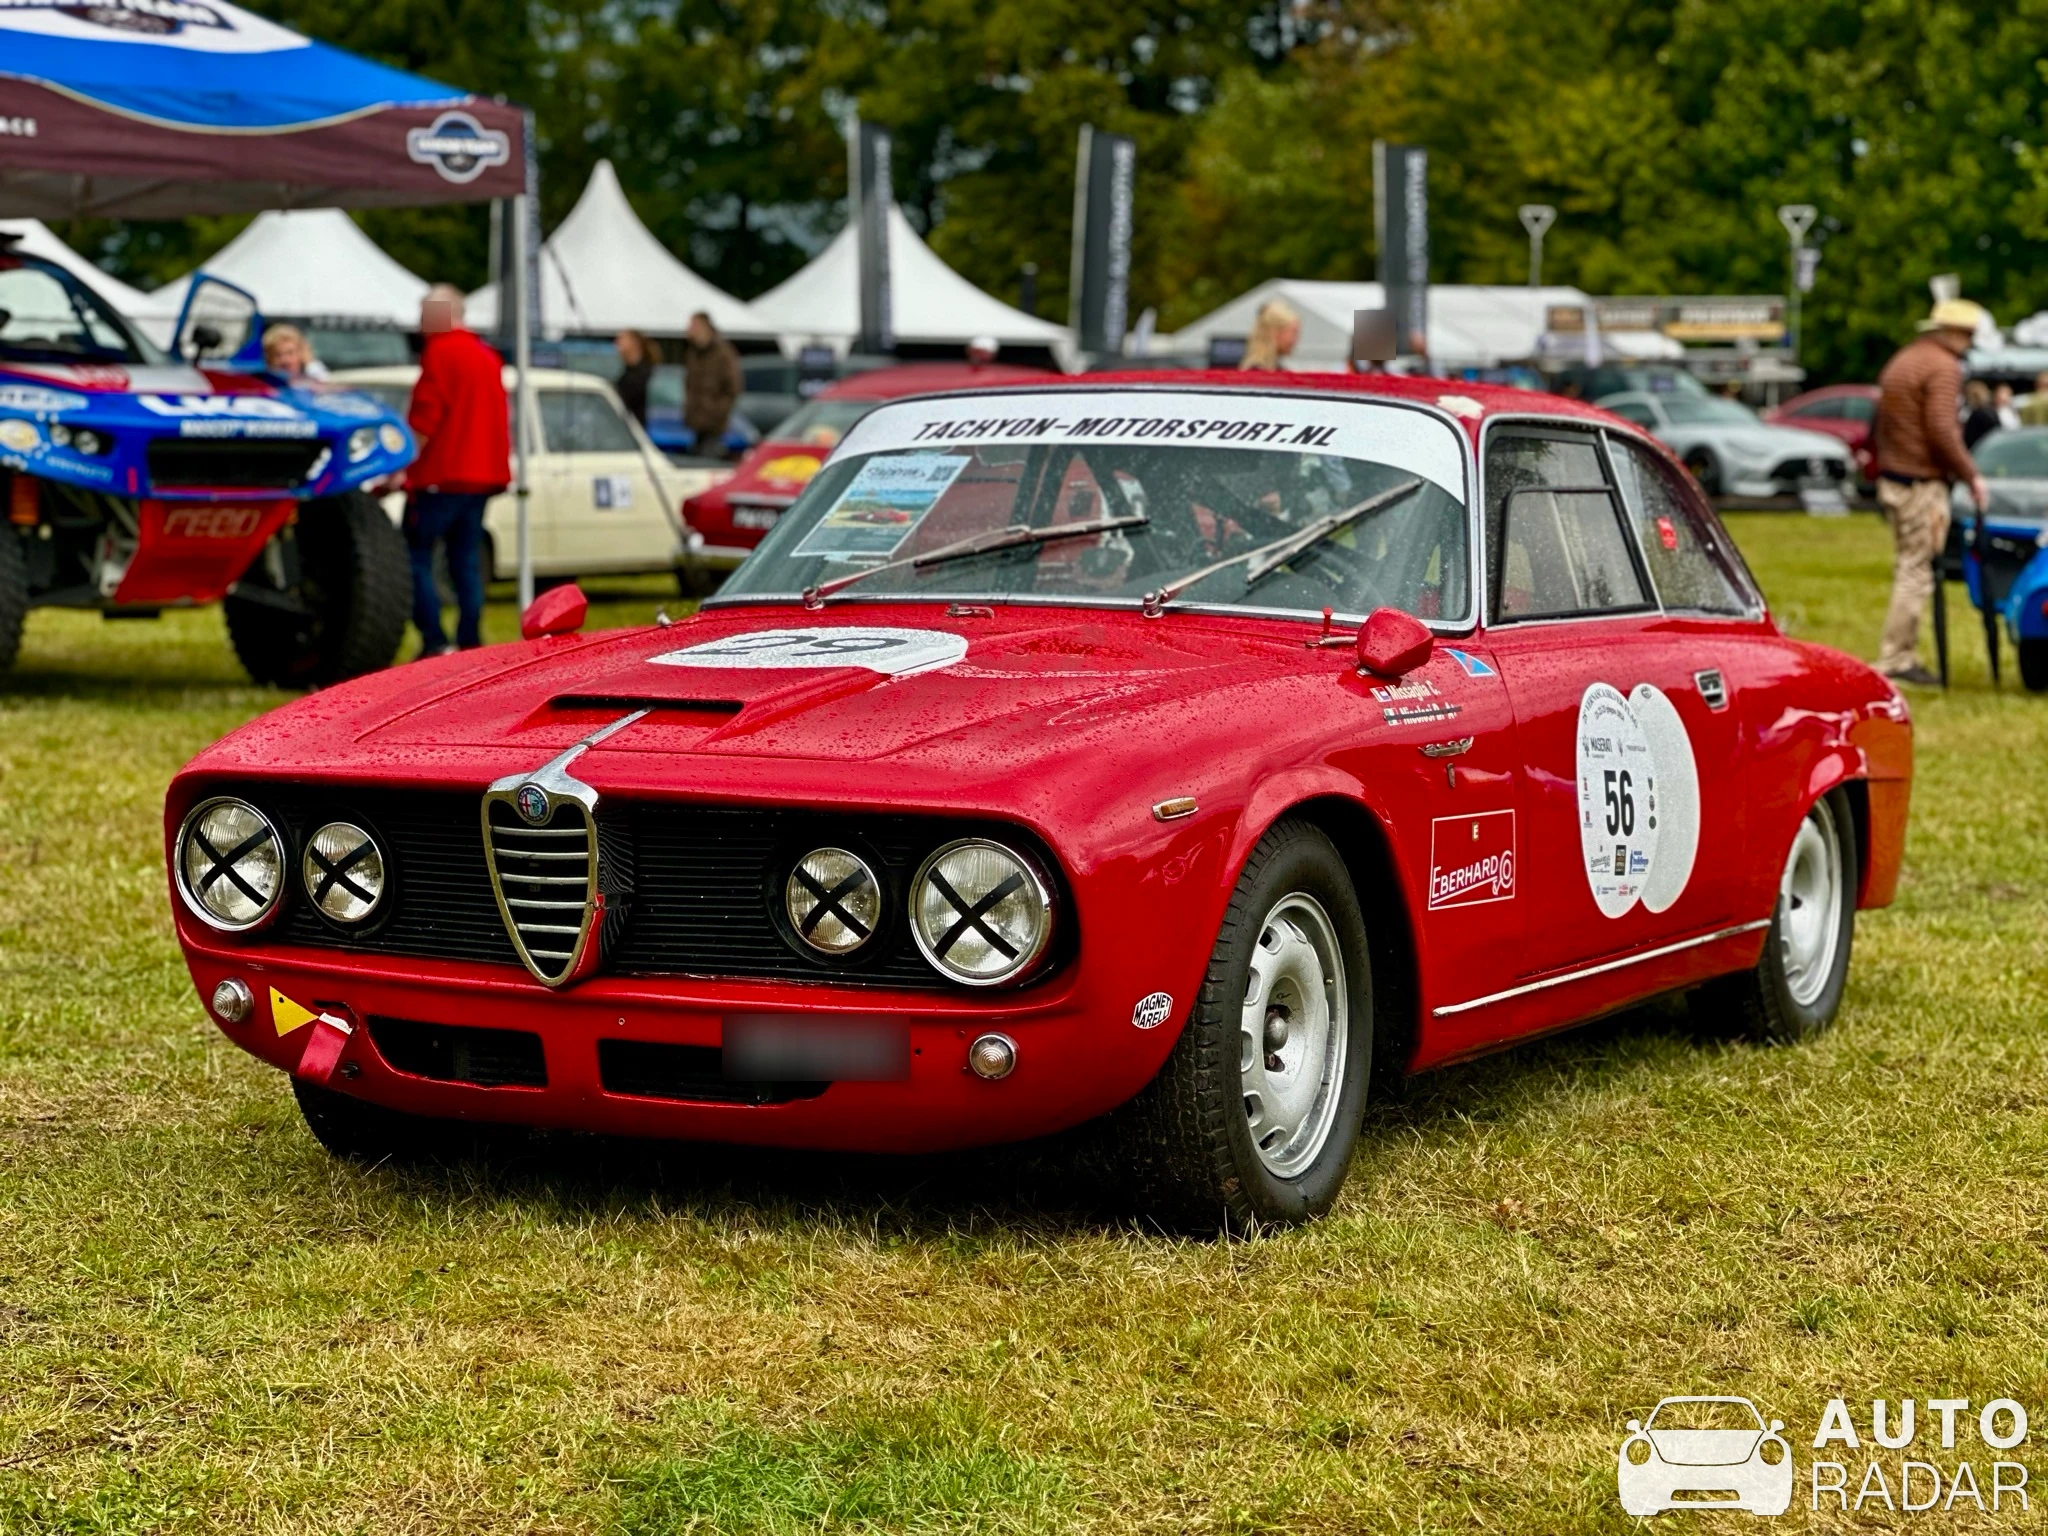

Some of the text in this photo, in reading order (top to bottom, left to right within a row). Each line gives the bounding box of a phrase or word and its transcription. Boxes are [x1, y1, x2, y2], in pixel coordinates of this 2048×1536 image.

[912, 417, 1338, 447] TACHYON-MOTORSPORT.NL
[670, 635, 909, 657] 29
[1385, 681, 1431, 701] Missaglia
[1603, 769, 1634, 836] 56
[1432, 855, 1499, 899] EBERHARD
